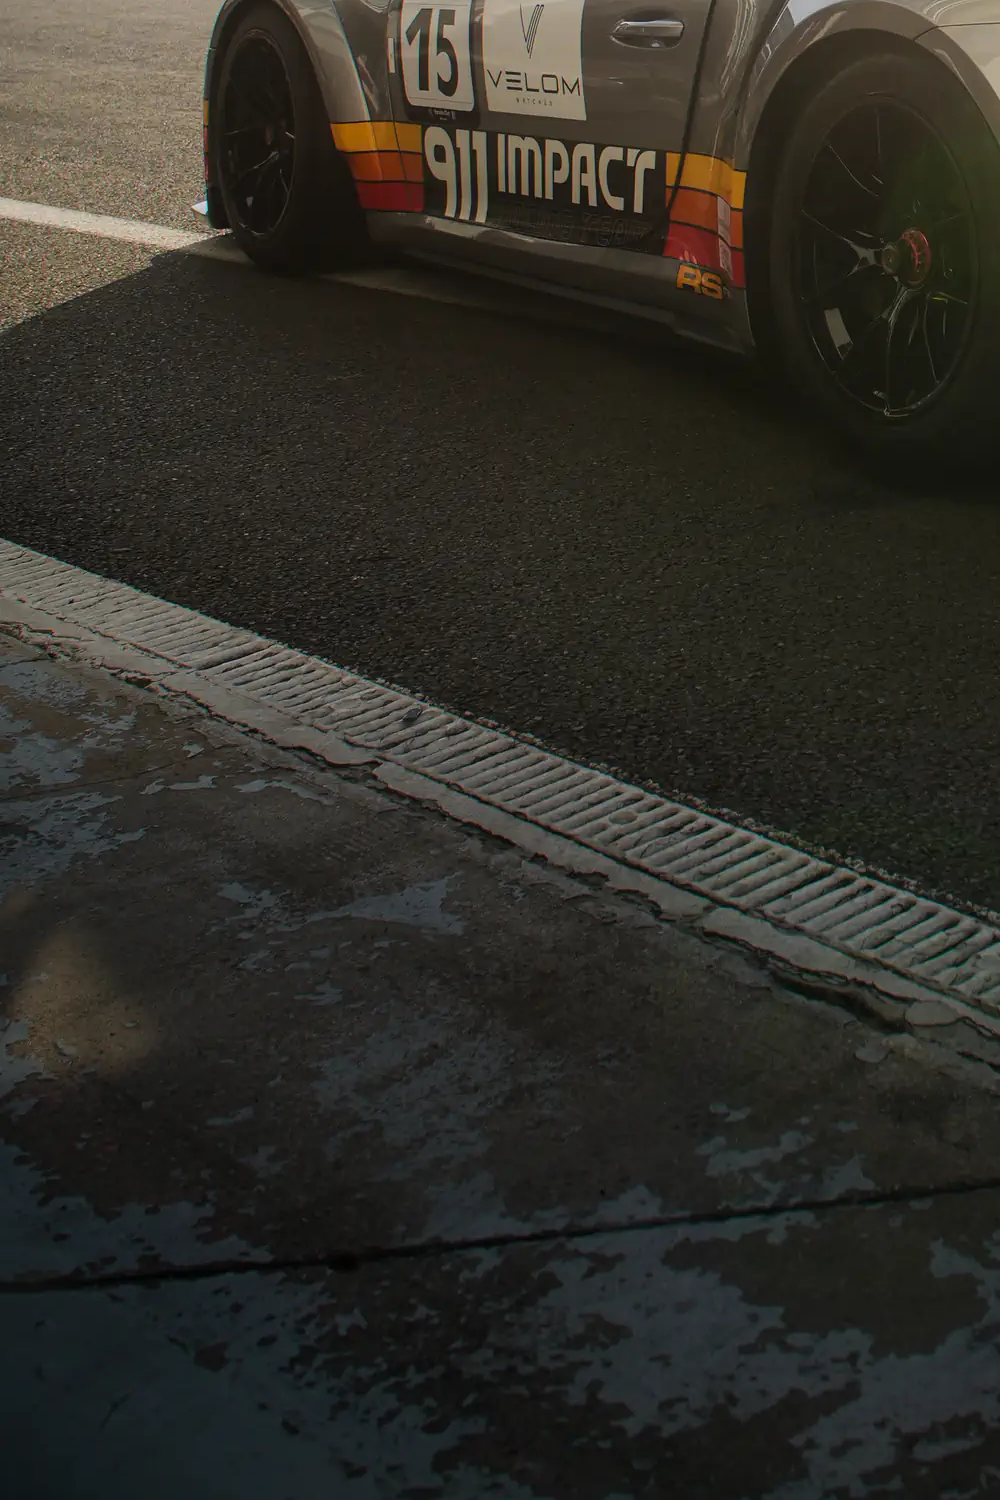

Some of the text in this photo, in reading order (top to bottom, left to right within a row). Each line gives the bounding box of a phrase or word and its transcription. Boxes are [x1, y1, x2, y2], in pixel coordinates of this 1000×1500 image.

[405, 7, 459, 97] 15
[487, 69, 581, 97] VELOM
[423, 125, 657, 223] 911 IMPACT
